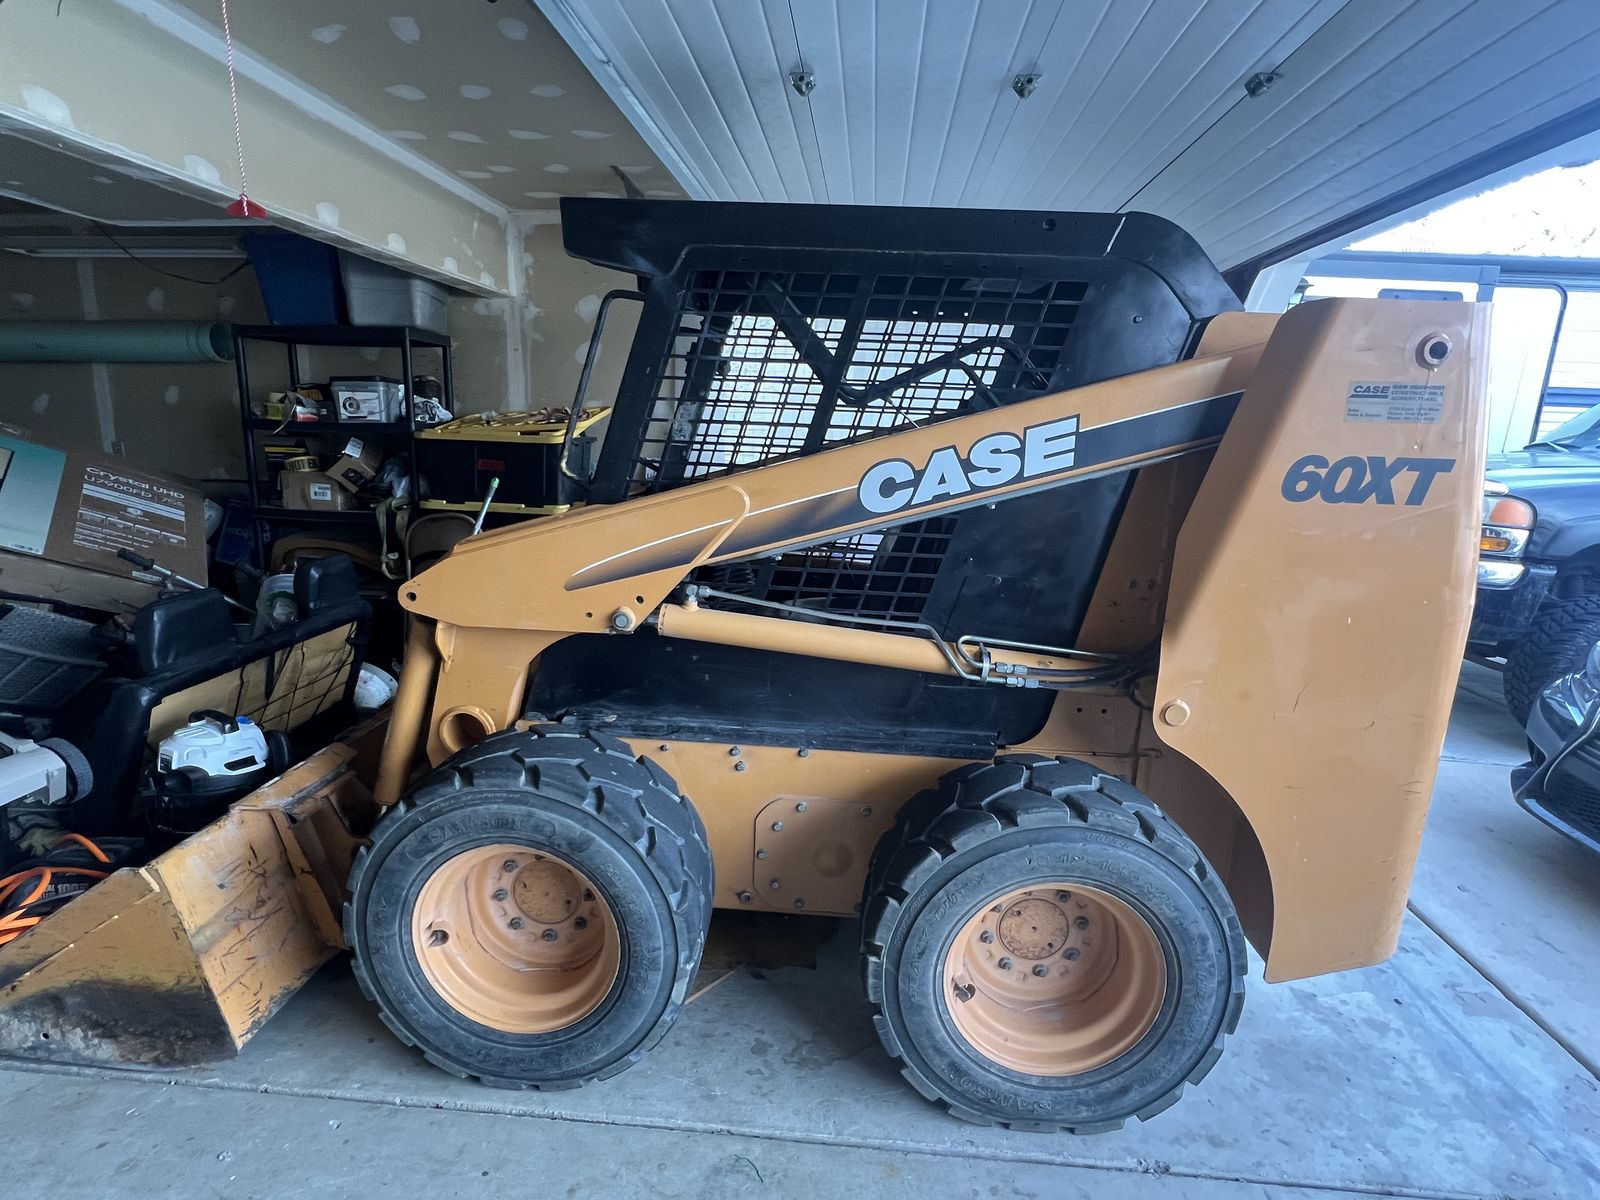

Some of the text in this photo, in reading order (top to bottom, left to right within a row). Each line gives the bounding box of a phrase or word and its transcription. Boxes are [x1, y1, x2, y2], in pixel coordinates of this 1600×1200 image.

[1353, 385, 1391, 394] CASE
[86, 467, 185, 499] Crystal UHD
[857, 413, 1080, 513] CASE
[1281, 454, 1457, 506] 60XT
